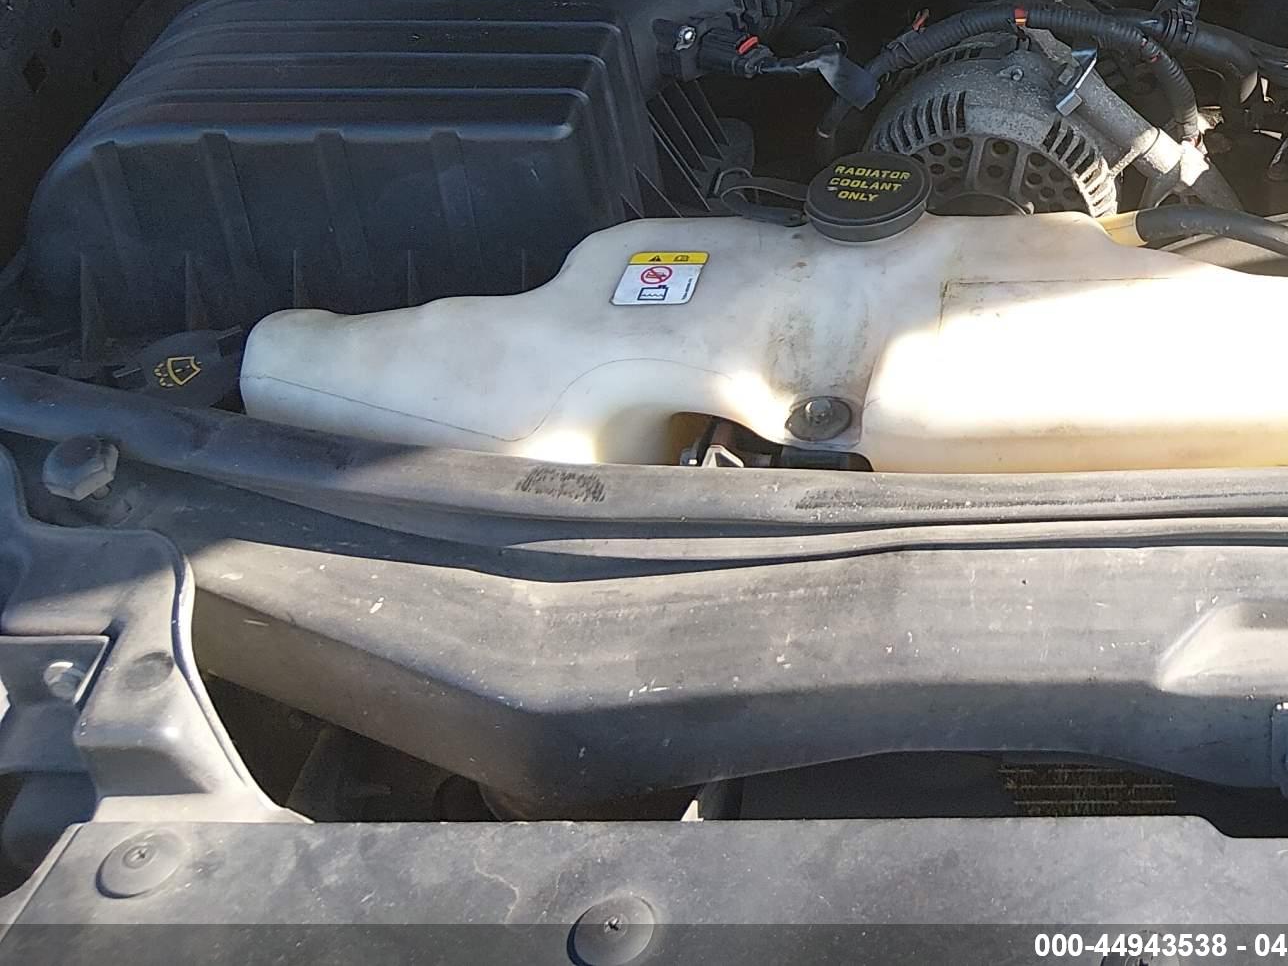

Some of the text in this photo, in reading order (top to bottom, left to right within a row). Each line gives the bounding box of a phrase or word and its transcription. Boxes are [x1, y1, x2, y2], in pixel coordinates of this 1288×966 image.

[834, 165, 912, 180] RADIATOR
[829, 177, 902, 191] COOLANT
[838, 190, 880, 202] ONLY
